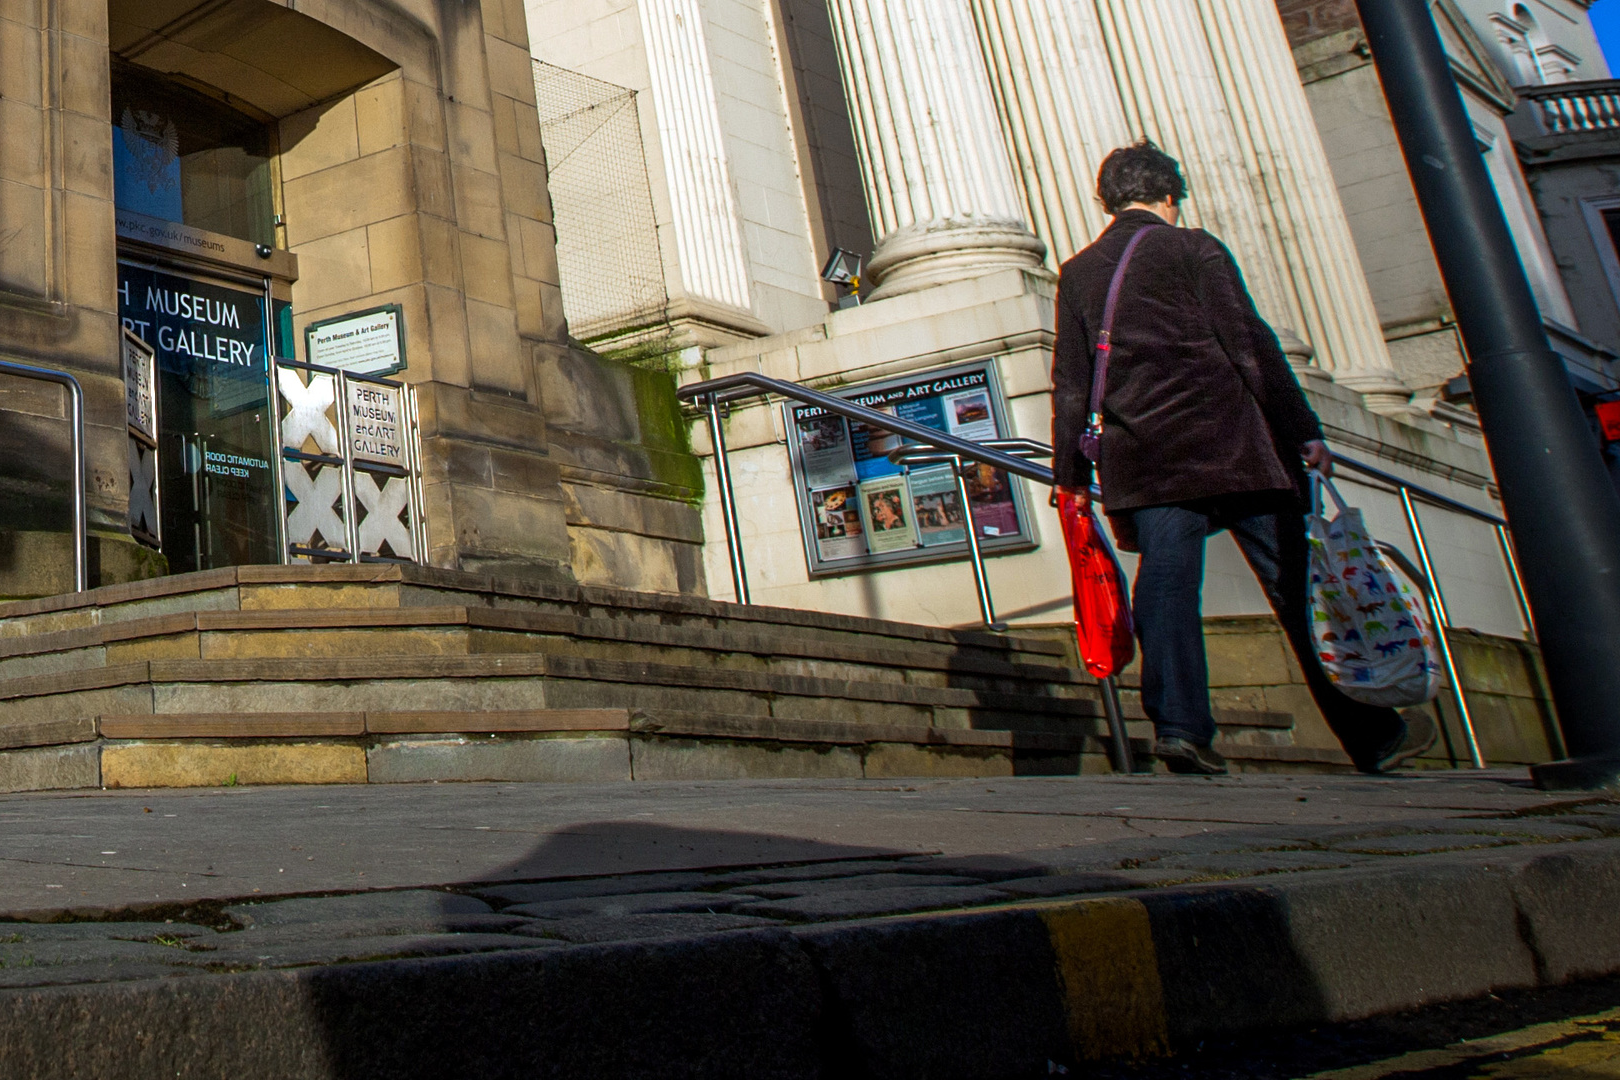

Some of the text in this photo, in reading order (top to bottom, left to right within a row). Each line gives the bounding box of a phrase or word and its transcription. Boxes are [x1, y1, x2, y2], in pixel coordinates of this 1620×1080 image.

[146, 286, 240, 329] MUSEUM
[317, 336, 332, 345] Perth
[332, 331, 355, 341] Museum
[361, 326, 370, 334] Art
[370, 322, 389, 332] Gallery
[158, 325, 255, 367] GALLERY
[907, 384, 931, 398] ART
[933, 373, 985, 392] GALLERY
[356, 388, 390, 406] PERTH
[353, 405, 396, 423] MUSEUM
[355, 424, 395, 440] and ART
[354, 439, 400, 457] GALLERY
